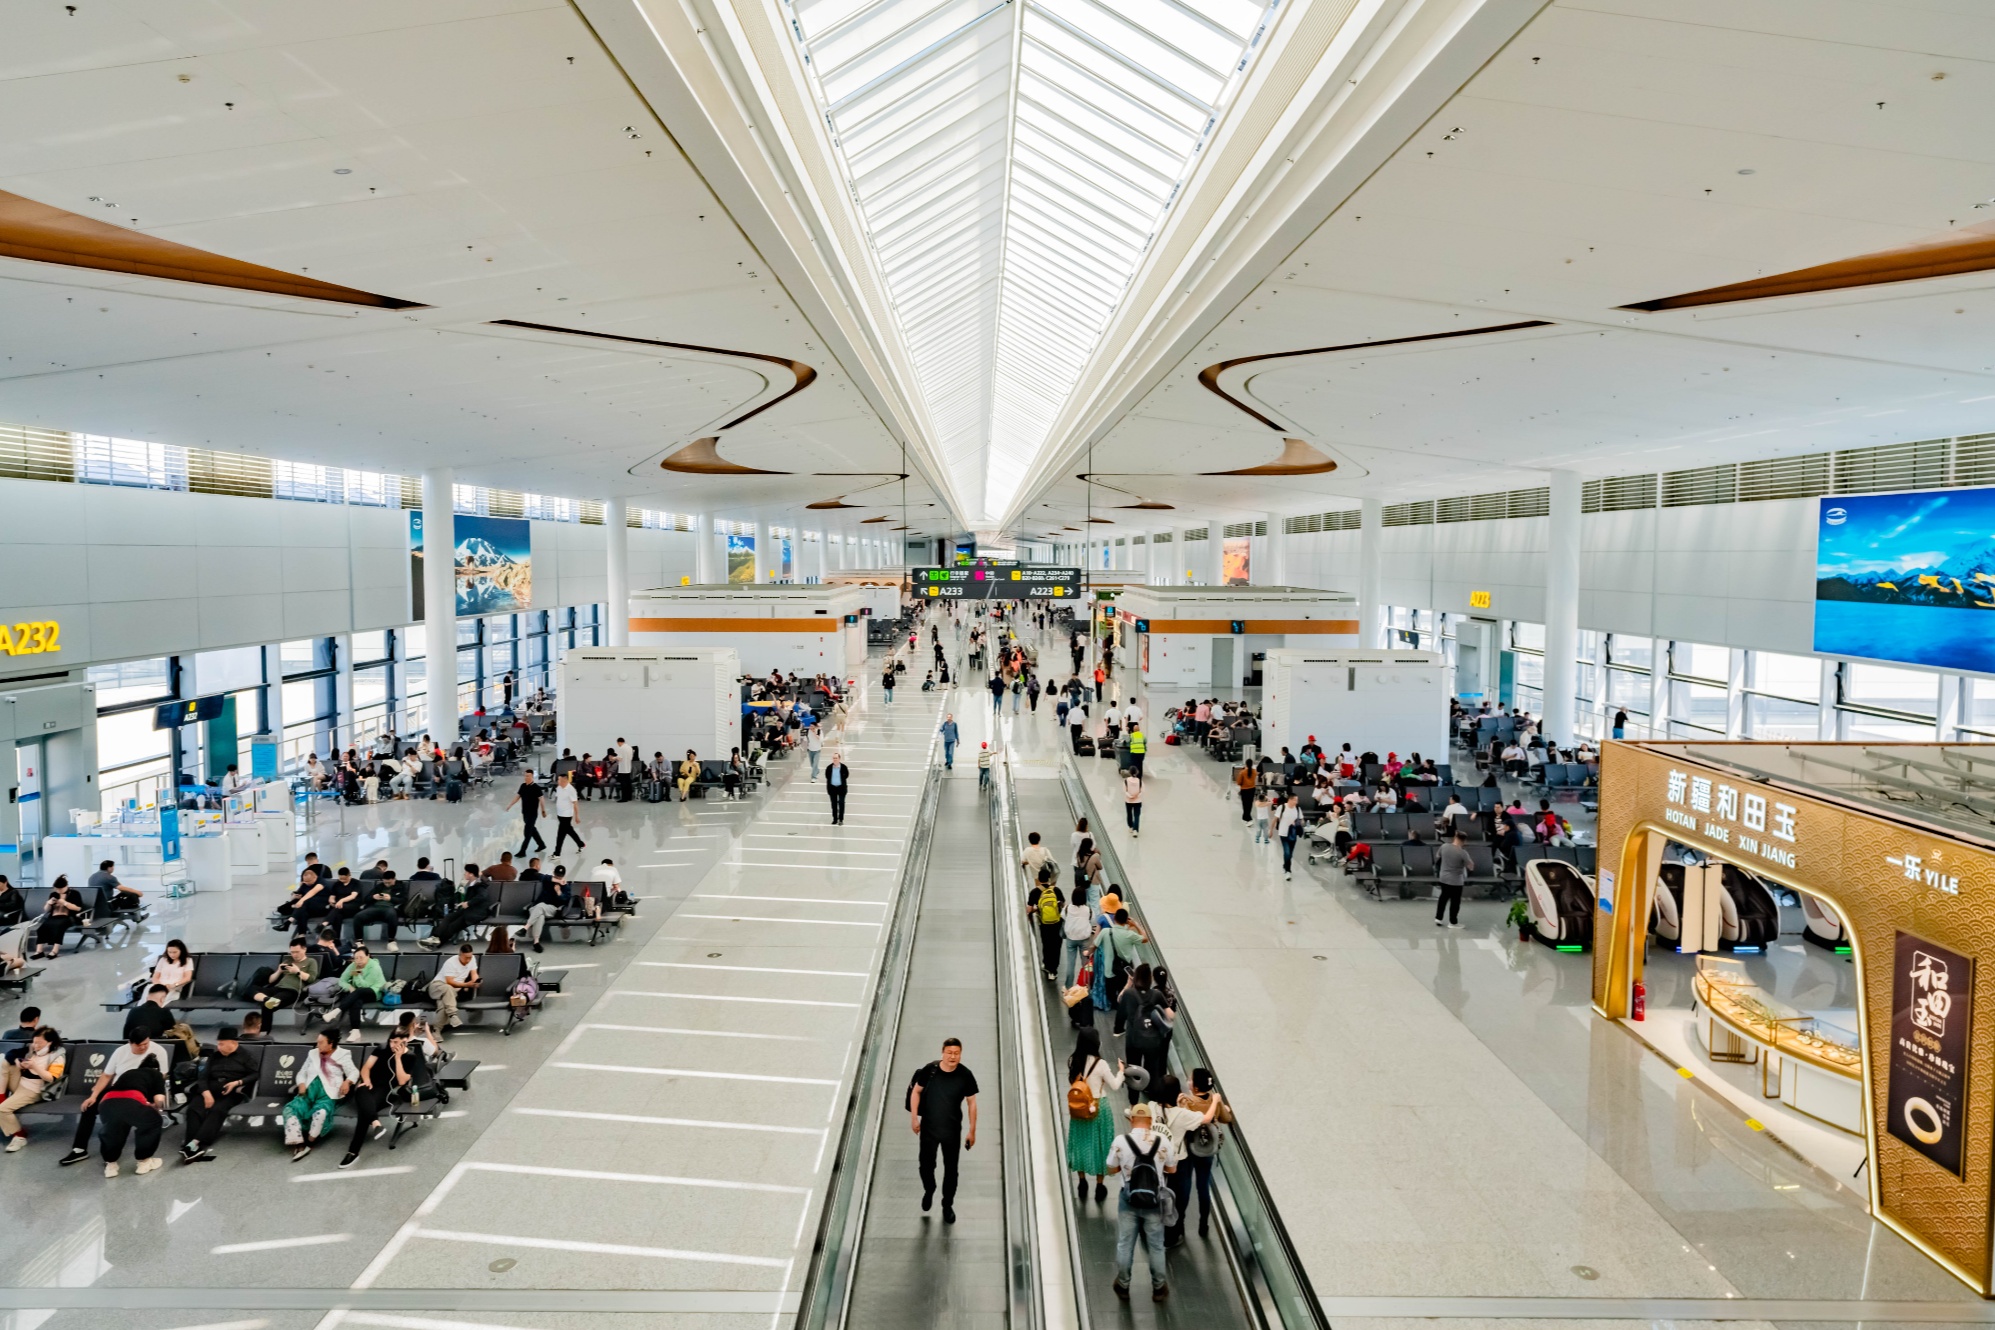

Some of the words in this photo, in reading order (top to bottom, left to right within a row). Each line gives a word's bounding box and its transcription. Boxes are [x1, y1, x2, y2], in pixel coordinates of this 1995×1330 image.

[940, 587, 963, 596] A233
[1029, 587, 1053, 596] A223
[0, 620, 61, 656] A232
[1667, 769, 1797, 843] 新疆和田玉
[1665, 808, 1697, 831] HOTAN
[1704, 822, 1730, 844] JADE
[1738, 835, 1758, 854] XIN
[1761, 843, 1796, 869] JIANG
[1885, 854, 1922, 882] 一乐
